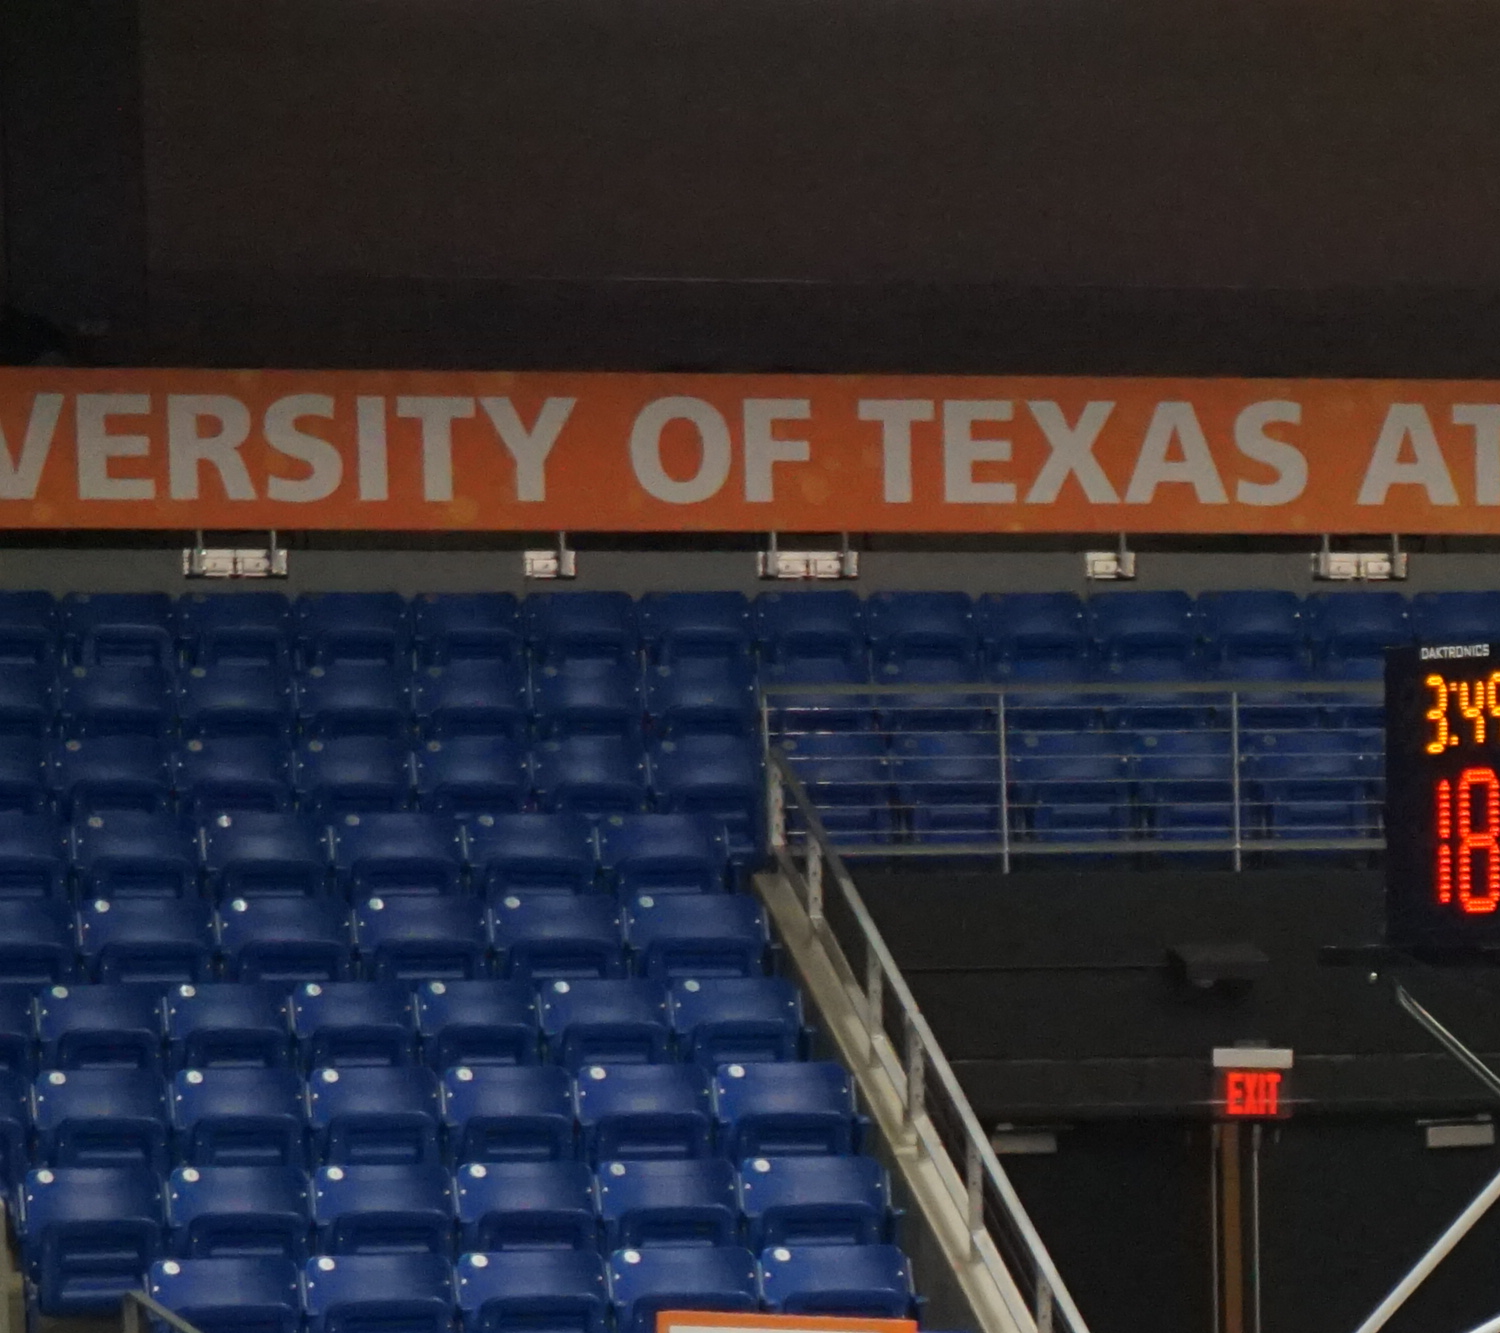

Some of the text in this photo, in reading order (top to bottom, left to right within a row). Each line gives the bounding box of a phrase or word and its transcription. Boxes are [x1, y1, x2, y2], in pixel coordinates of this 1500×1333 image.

[629, 396, 812, 506] OF
[858, 397, 1309, 507] TEXAS
[1420, 643, 1490, 660] DAKTRONICS
[1436, 766, 1500, 914] 18
[1226, 1072, 1282, 1115] EXIT
